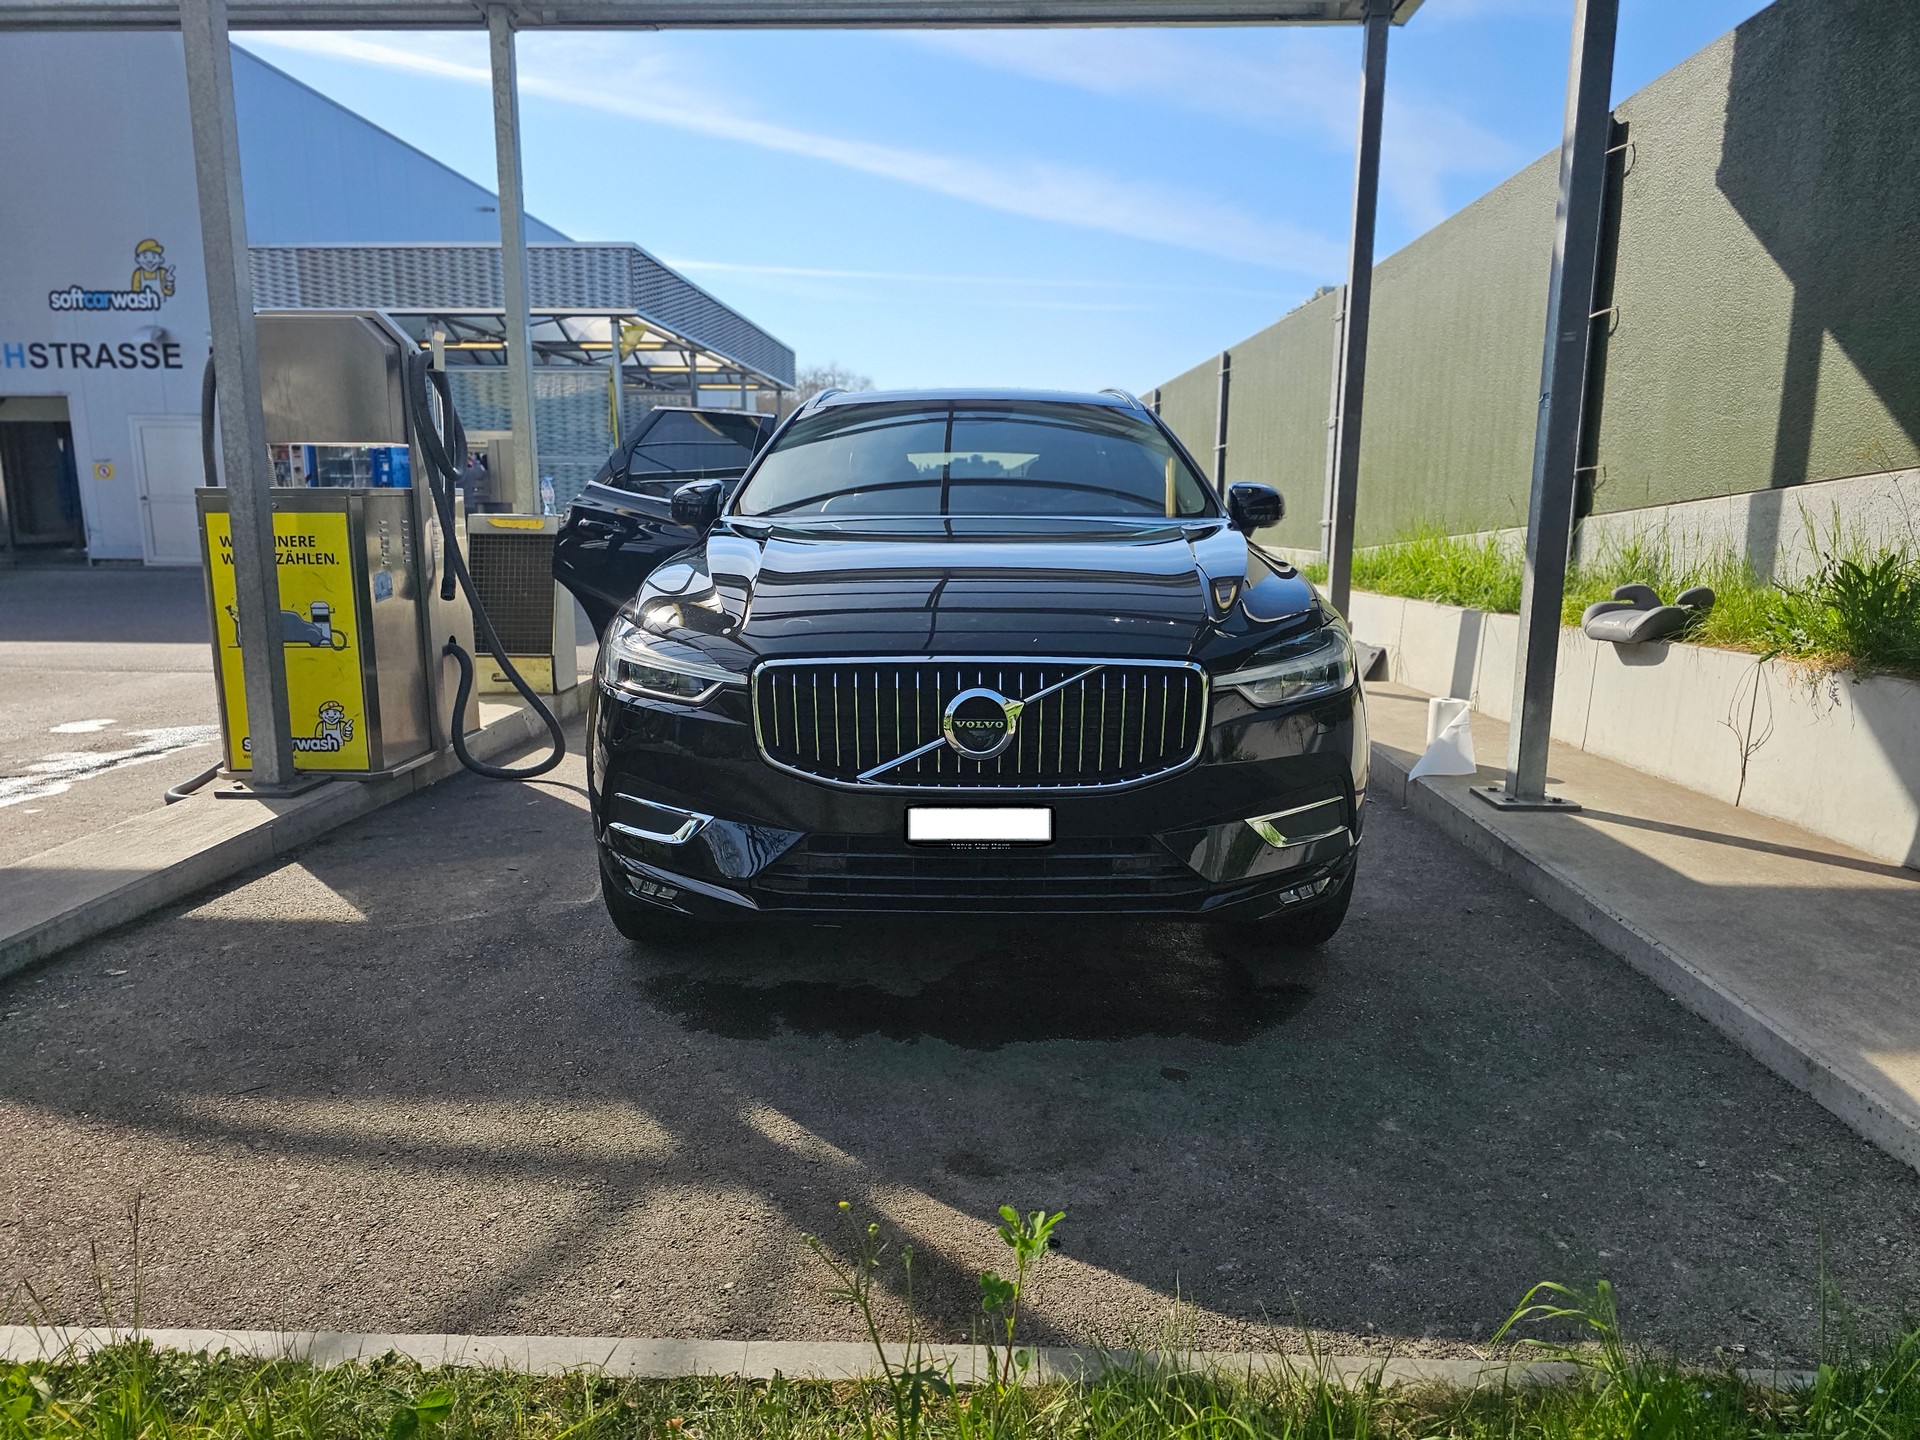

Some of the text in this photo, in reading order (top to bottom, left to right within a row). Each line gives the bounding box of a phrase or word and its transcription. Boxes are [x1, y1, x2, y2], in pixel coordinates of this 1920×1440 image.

[50, 286, 160, 310] softcarwash
[0, 342, 183, 369] HSTRASSE
[954, 720, 1005, 729] VOLVO
